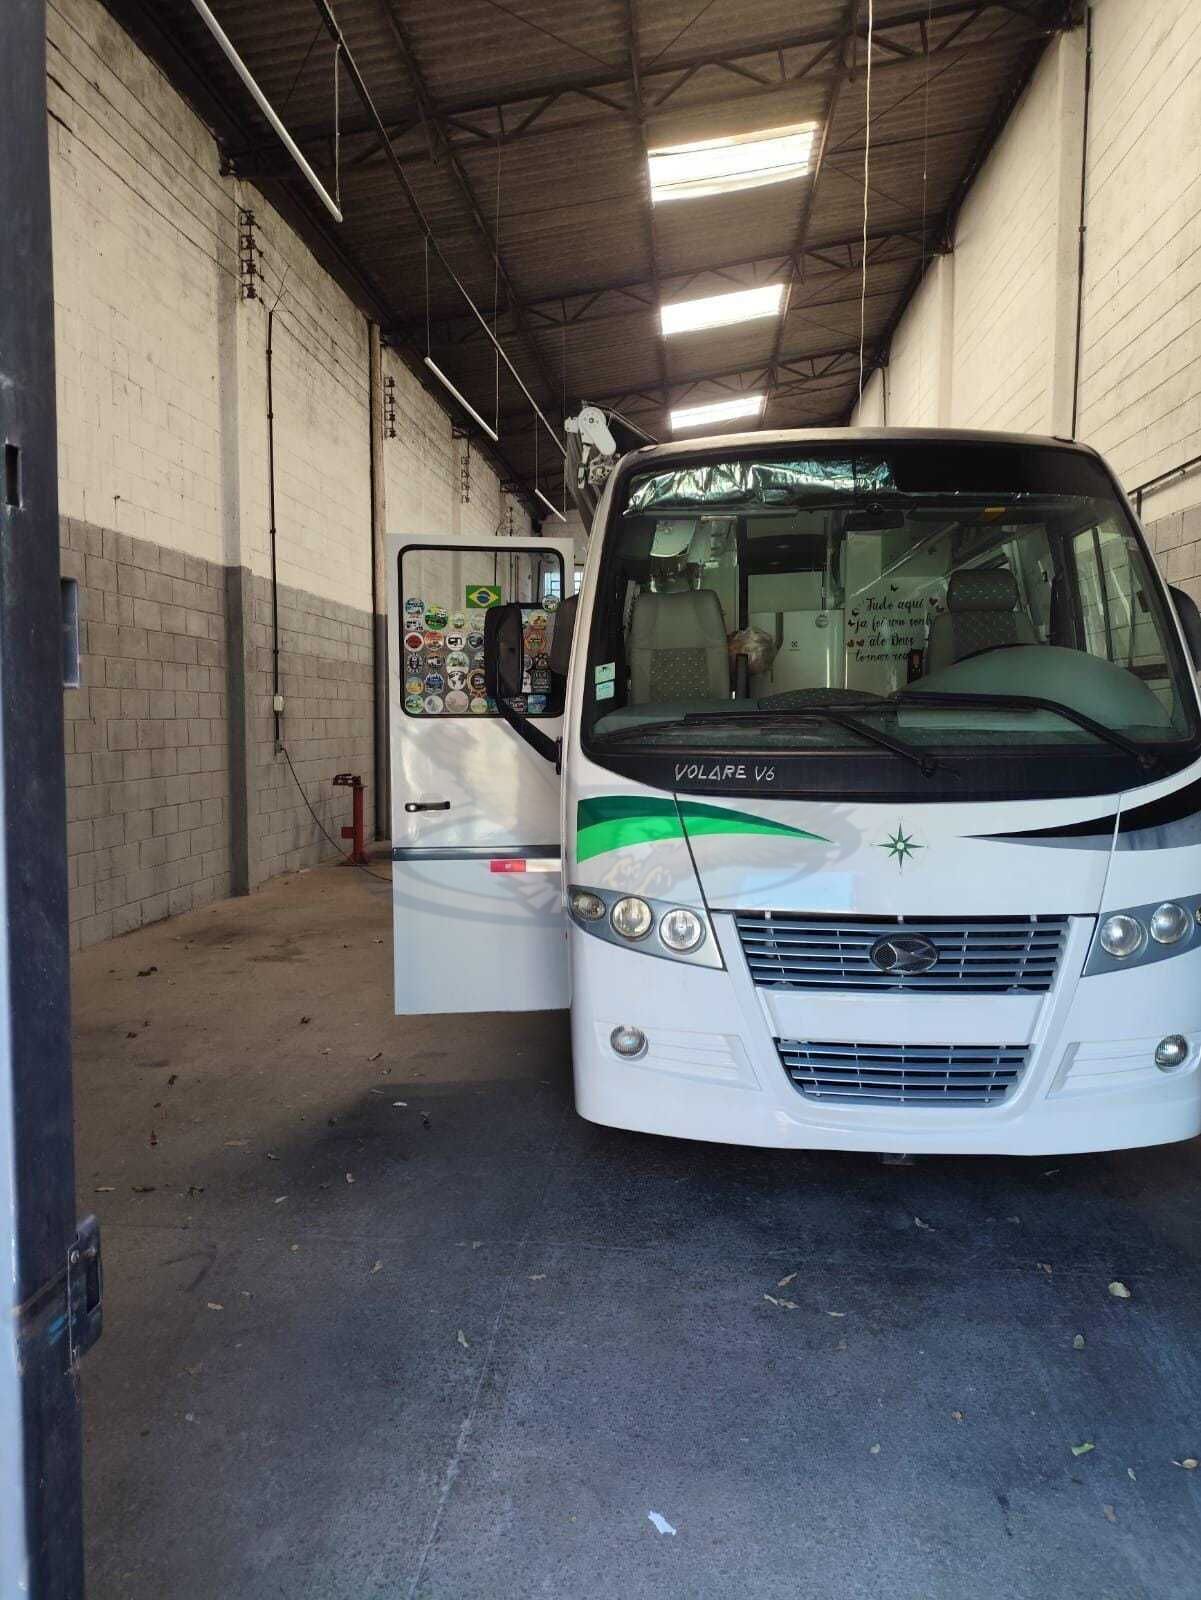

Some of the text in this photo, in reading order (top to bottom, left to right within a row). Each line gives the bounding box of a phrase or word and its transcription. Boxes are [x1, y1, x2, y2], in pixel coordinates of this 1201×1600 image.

[866, 597, 894, 611] Tudo
[674, 763, 775, 782] VOLARE V6
